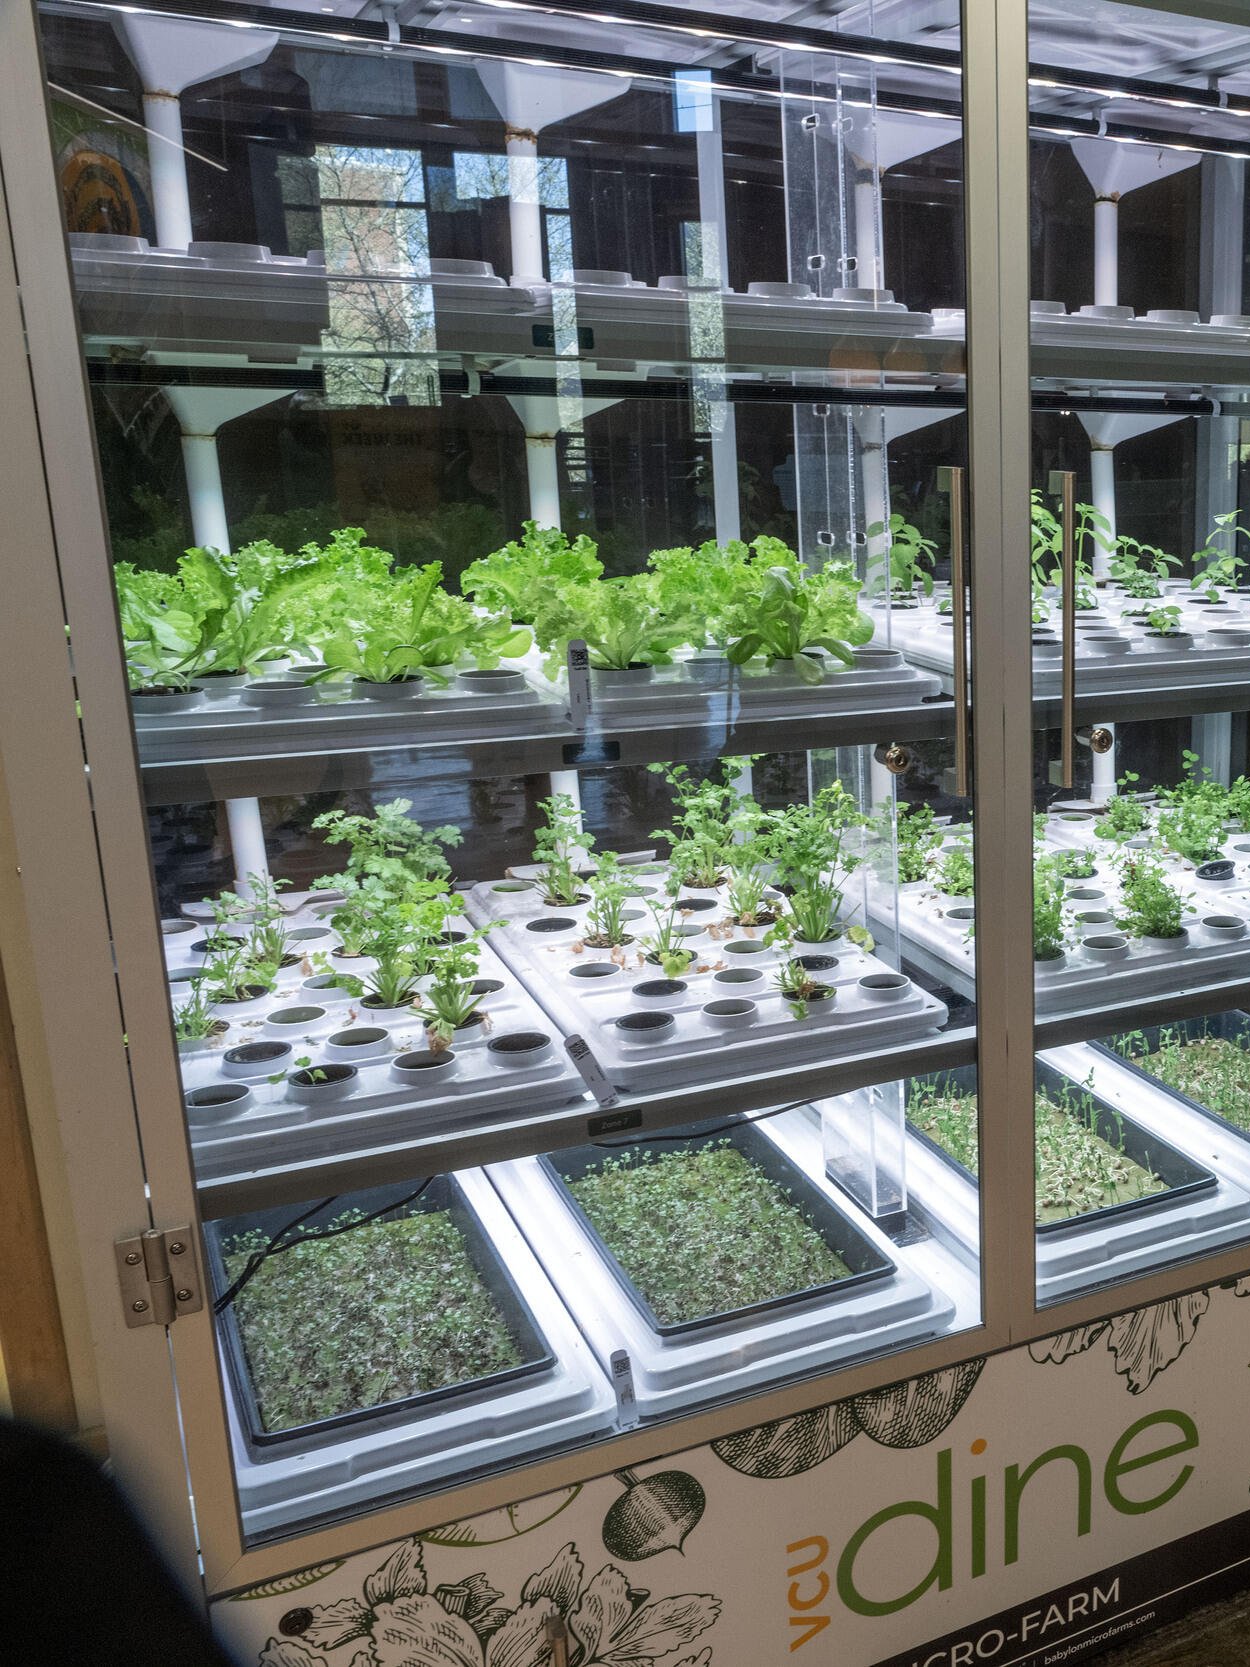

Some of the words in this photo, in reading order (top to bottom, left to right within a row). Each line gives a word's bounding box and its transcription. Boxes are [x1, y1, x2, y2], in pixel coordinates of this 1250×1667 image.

[600, 1120, 623, 1130] Zone
[836, 1409, 1200, 1617] dine
[786, 1535, 831, 1653] VCU
[1044, 1611, 1156, 1665] babylonmicrofarms.com
